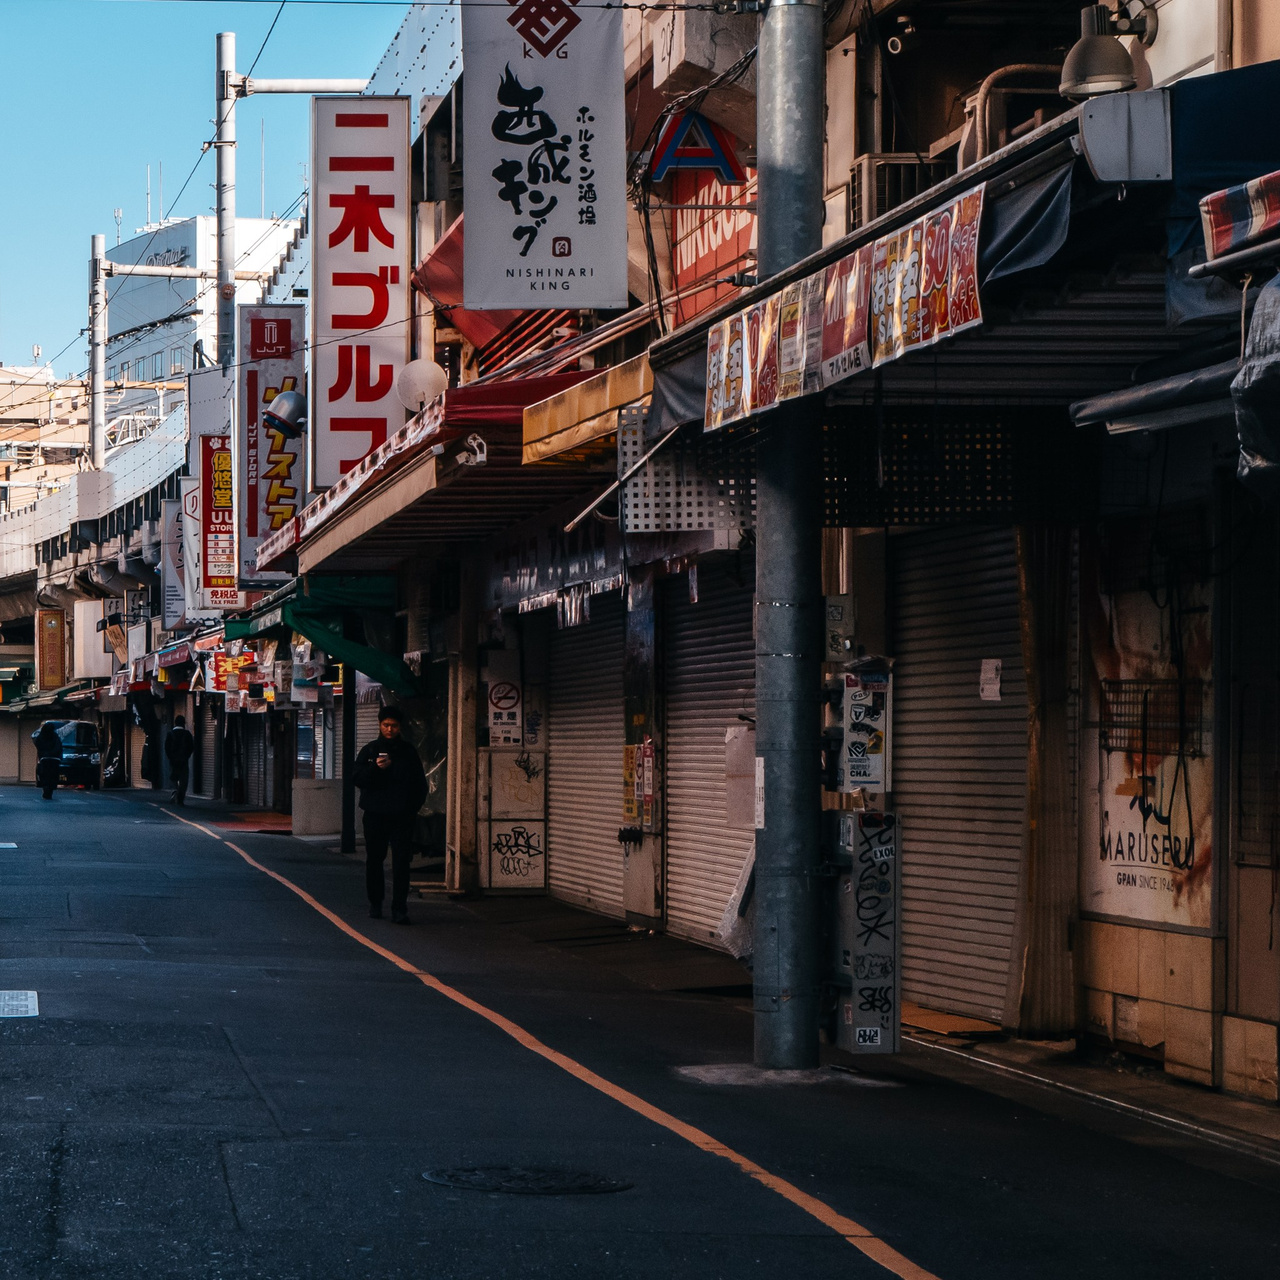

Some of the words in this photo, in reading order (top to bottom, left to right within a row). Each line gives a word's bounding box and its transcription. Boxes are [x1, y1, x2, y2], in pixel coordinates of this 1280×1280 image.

[576, 106, 597, 225] ホルモン酒場
[506, 268, 595, 278] NISHINARI
[530, 280, 570, 291] KING
[256, 345, 286, 353] JJT
[248, 449, 258, 486] STORE
[210, 589, 238, 599] 免税店
[492, 711, 518, 721] 禁煙
[1100, 831, 1195, 870] MARUSERU
